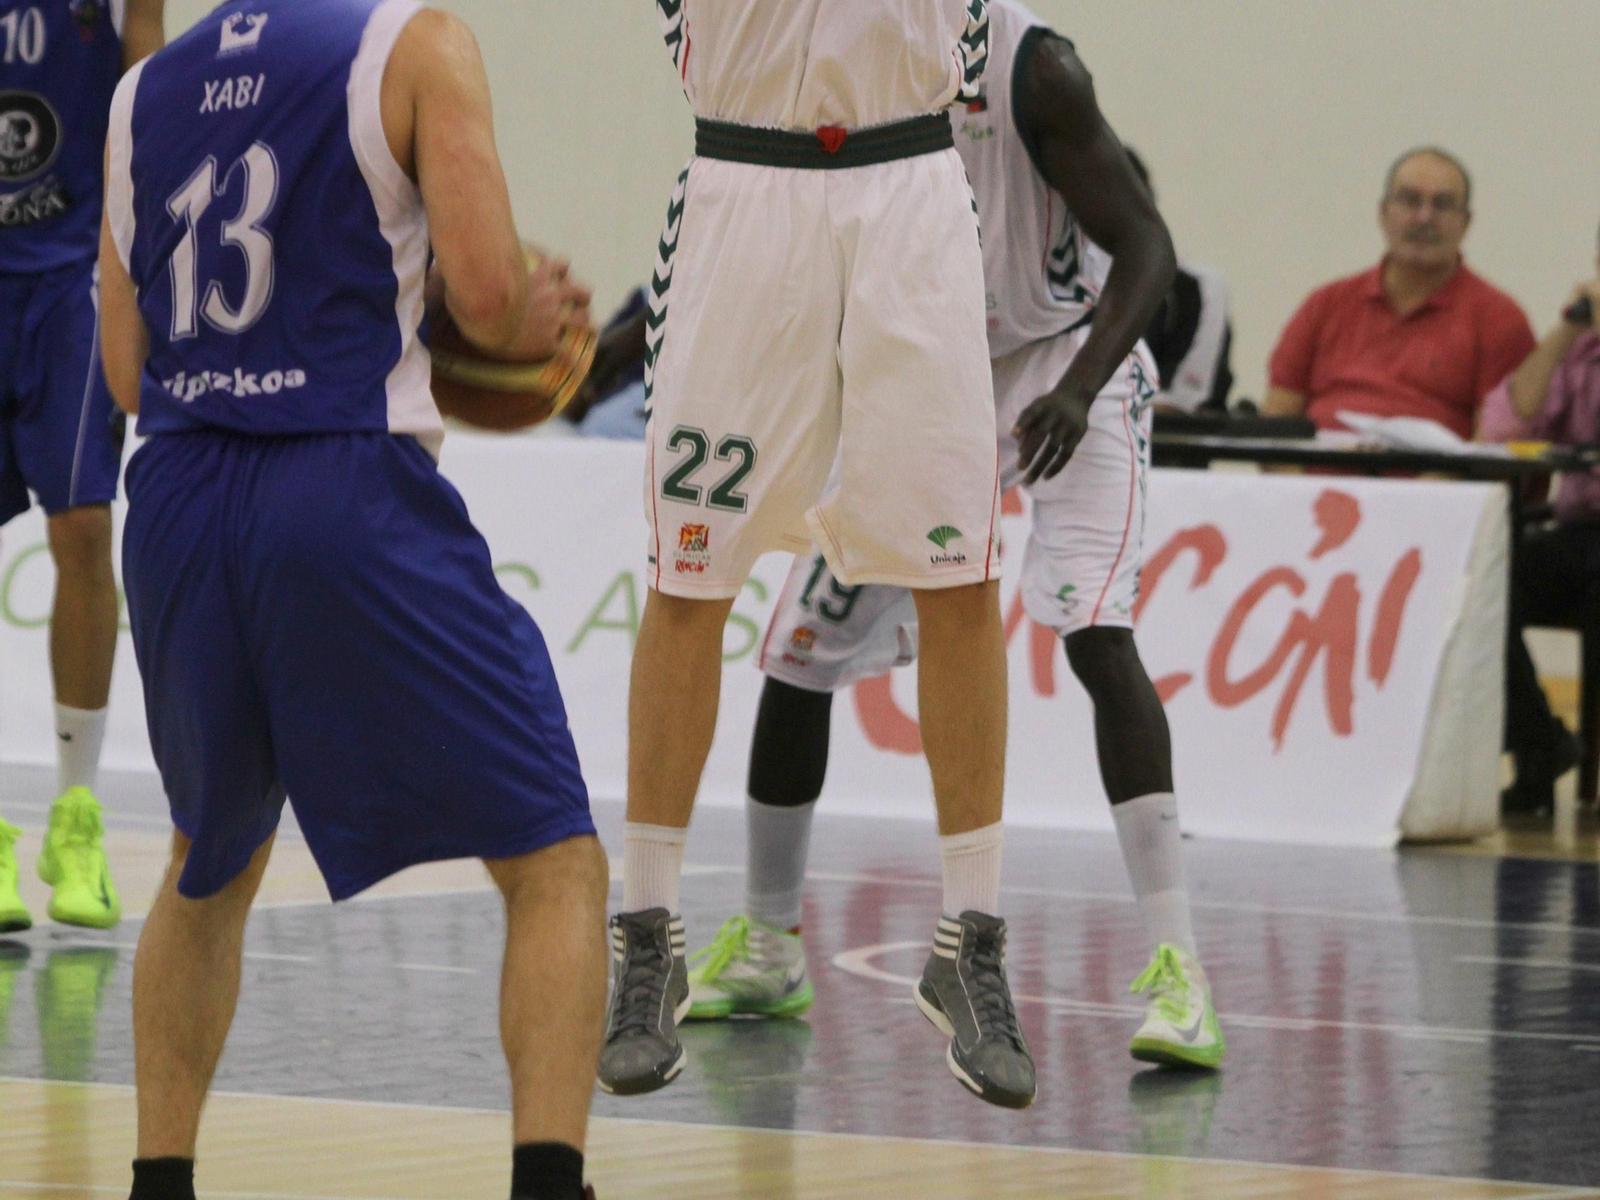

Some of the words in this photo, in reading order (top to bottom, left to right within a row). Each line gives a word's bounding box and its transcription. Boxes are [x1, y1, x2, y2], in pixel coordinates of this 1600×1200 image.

[0, 7, 46, 64] 10
[200, 73, 266, 114] XABI
[166, 139, 280, 342] 13
[661, 424, 757, 514] 22
[930, 551, 966, 565] Unicaja
